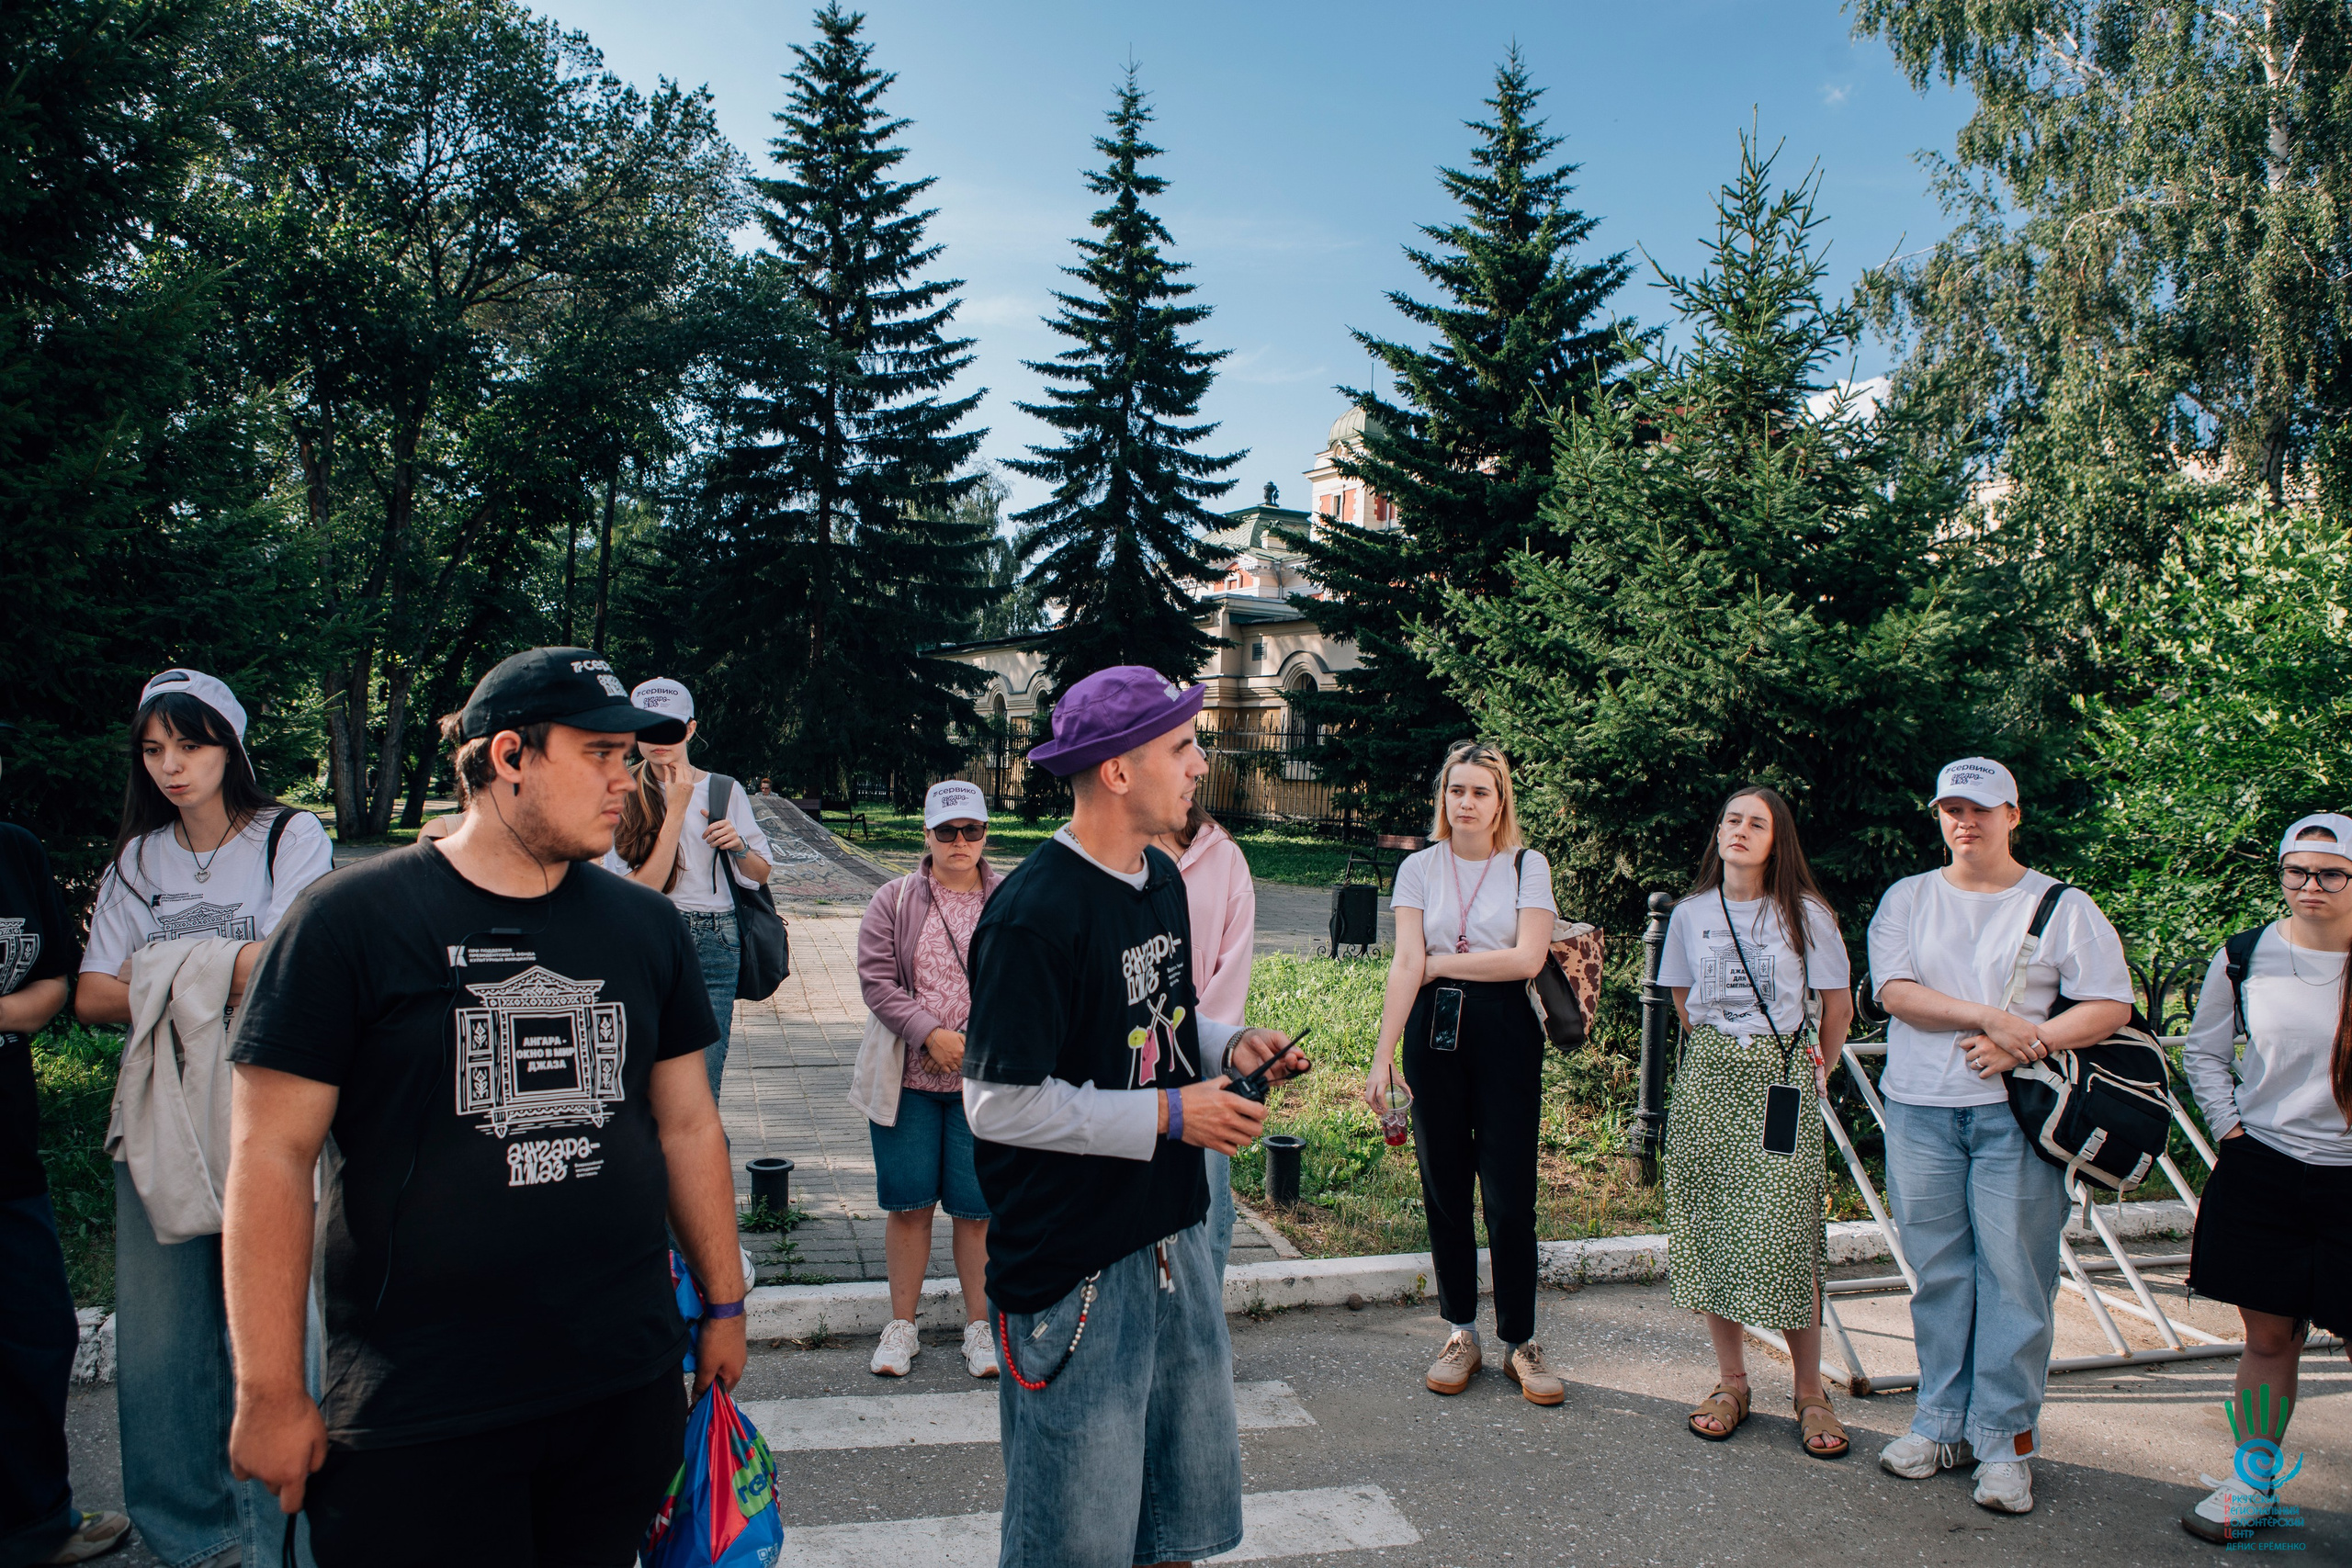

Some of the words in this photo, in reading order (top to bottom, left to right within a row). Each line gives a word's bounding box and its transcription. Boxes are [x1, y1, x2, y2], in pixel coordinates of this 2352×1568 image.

[641, 688, 679, 696] сервико
[1951, 764, 1996, 775] сервико
[938, 786, 977, 795] сервико
[523, 1035, 562, 1047] АНГАРА
[515, 1048, 544, 1059] ОКНО
[545, 1048, 553, 1057] В
[553, 1046, 575, 1057] МИР
[527, 1059, 567, 1073] ДЖАЗА
